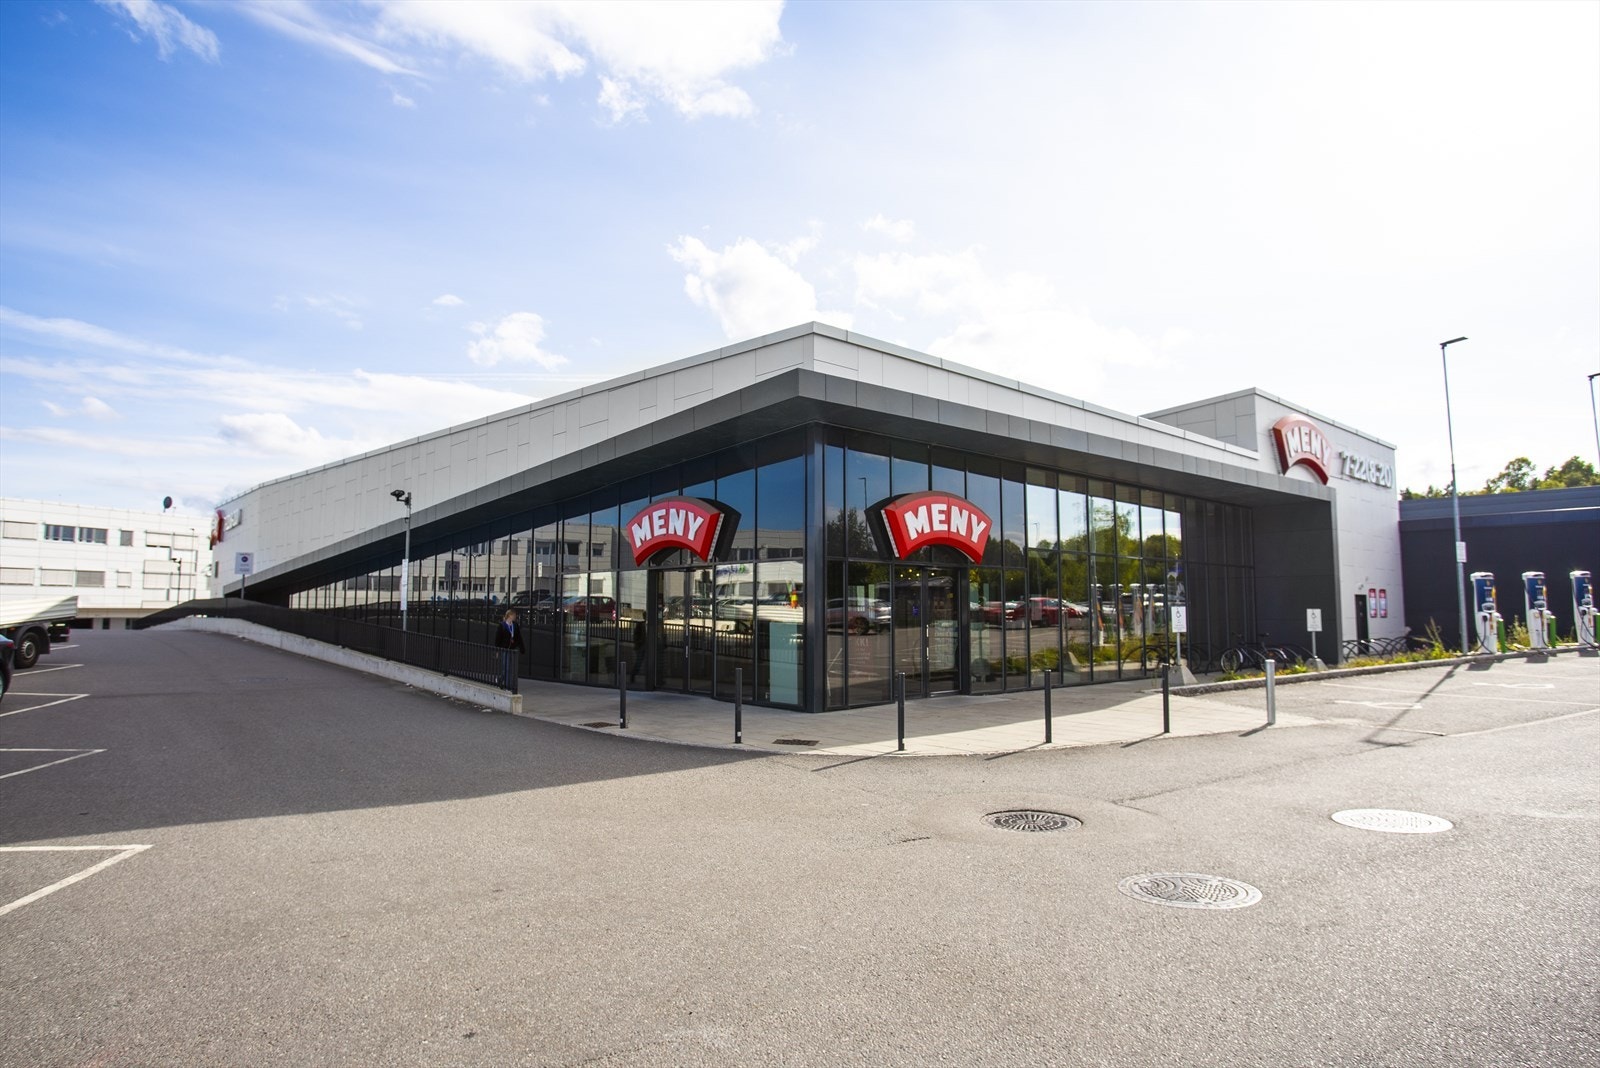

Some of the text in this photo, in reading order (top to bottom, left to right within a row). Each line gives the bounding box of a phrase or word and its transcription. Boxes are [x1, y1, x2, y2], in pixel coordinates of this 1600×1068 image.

[1285, 426, 1331, 467] MENY
[631, 508, 705, 549] MENY
[903, 503, 987, 544] MENY
